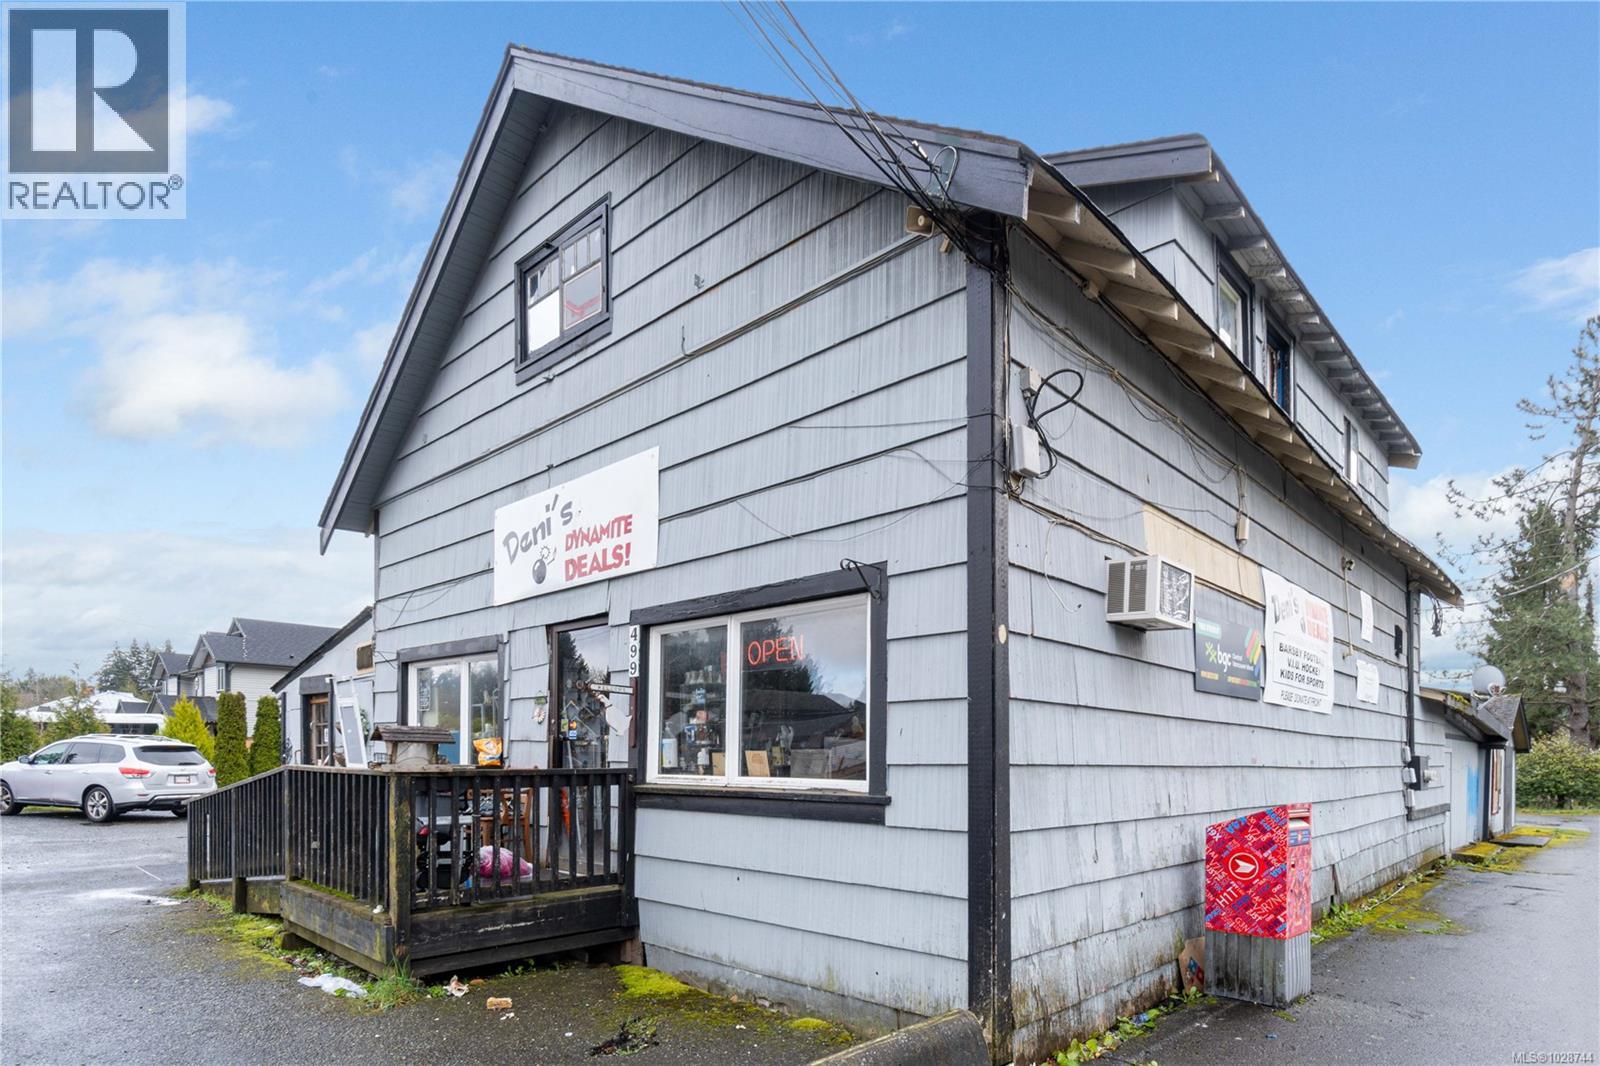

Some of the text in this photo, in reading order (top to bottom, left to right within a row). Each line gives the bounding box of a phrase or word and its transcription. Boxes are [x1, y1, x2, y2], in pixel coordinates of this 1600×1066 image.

[502, 494, 573, 565] Deni's
[565, 514, 633, 552] DYNAMITE
[565, 542, 631, 582] DEALS!
[630, 627, 638, 676] 499
[747, 634, 806, 666] OPEN
[1217, 643, 1232, 673] bgc
[1280, 669, 1325, 689] KIDS FOR SPORTS
